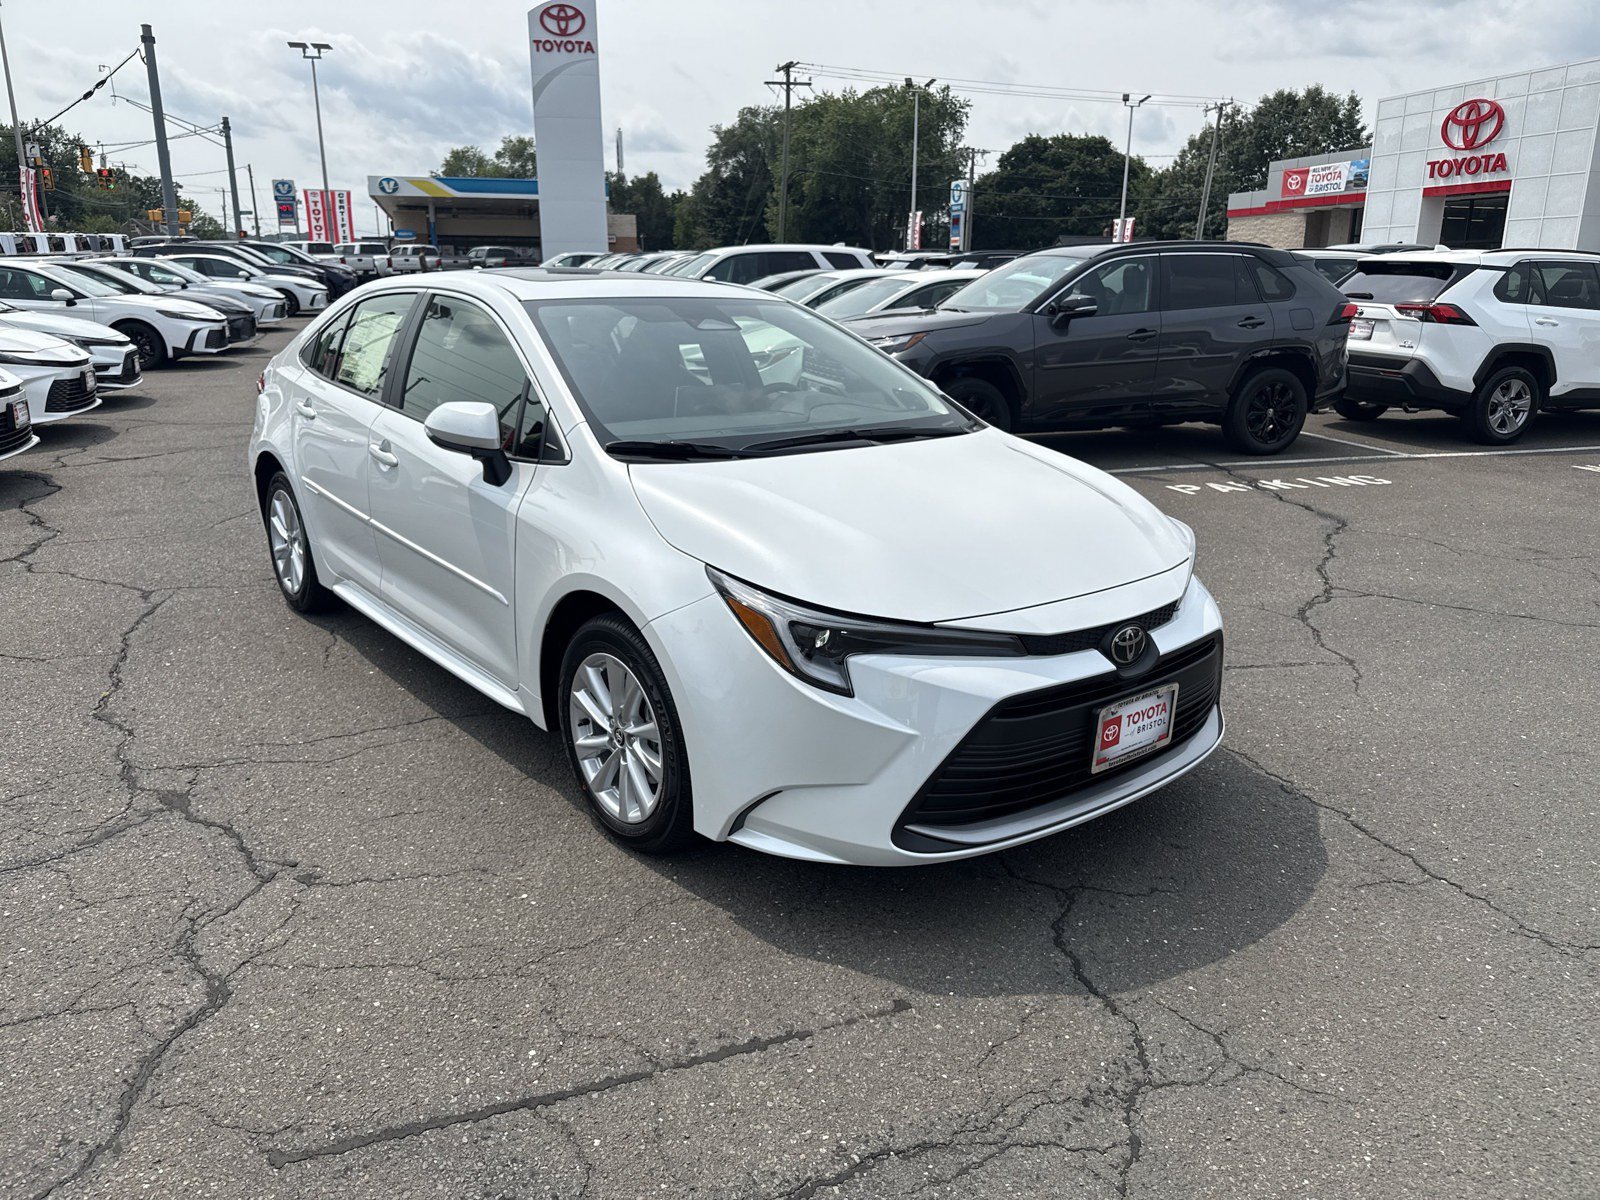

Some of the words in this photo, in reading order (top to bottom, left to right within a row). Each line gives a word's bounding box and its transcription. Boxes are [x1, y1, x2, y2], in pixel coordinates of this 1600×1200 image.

[532, 39, 596, 54] TOYOTA
[1426, 152, 1508, 179] TOYOTA
[1311, 171, 1342, 184] TOYOTA
[1314, 181, 1342, 193] BRISTOL
[311, 200, 323, 241] TOYOT
[337, 192, 349, 243] CERTIFIE
[1165, 475, 1392, 495] PARKING
[1126, 702, 1167, 727] TOYOTA
[1136, 717, 1166, 734] BRISTOL
